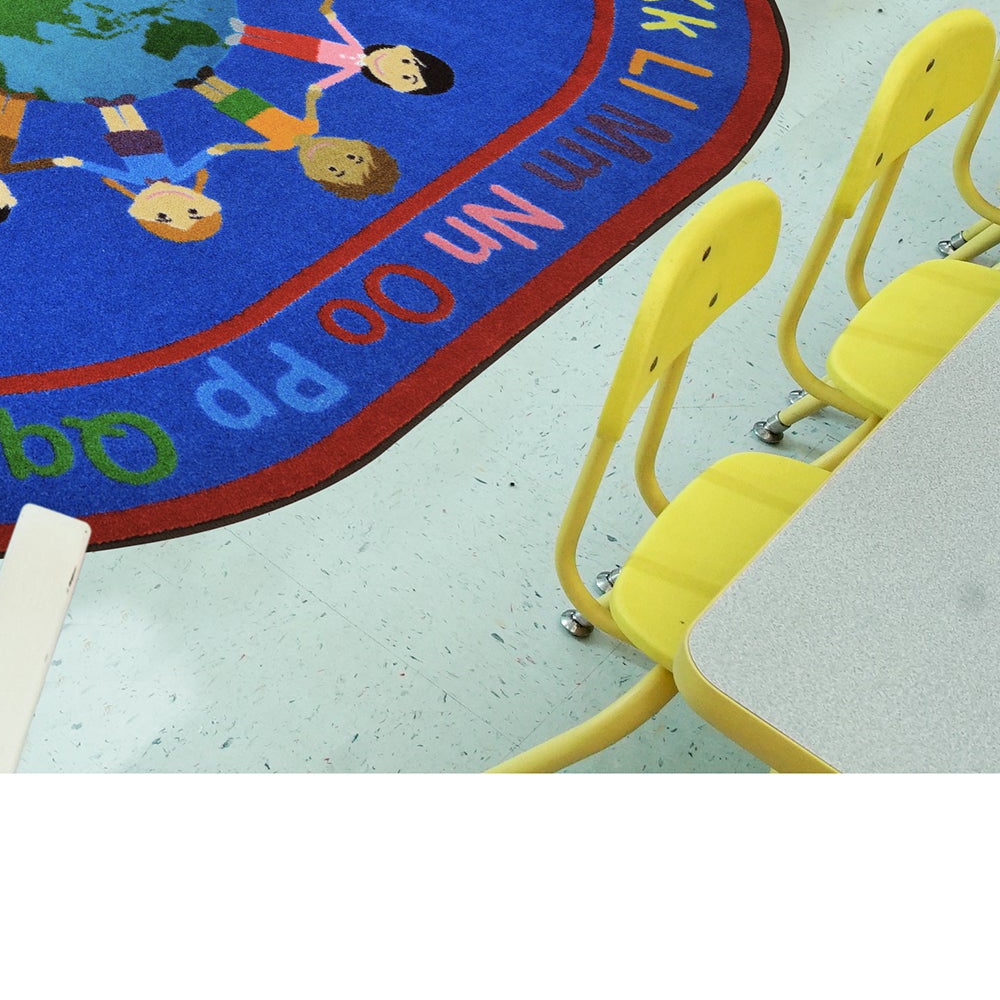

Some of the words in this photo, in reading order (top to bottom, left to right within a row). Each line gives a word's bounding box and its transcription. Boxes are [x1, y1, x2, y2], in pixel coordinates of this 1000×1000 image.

[619, 48, 714, 111] Ll
[520, 103, 674, 192] Mm
[423, 184, 566, 264] Nn
[317, 263, 456, 346] Oo
[195, 341, 349, 430] Pp
